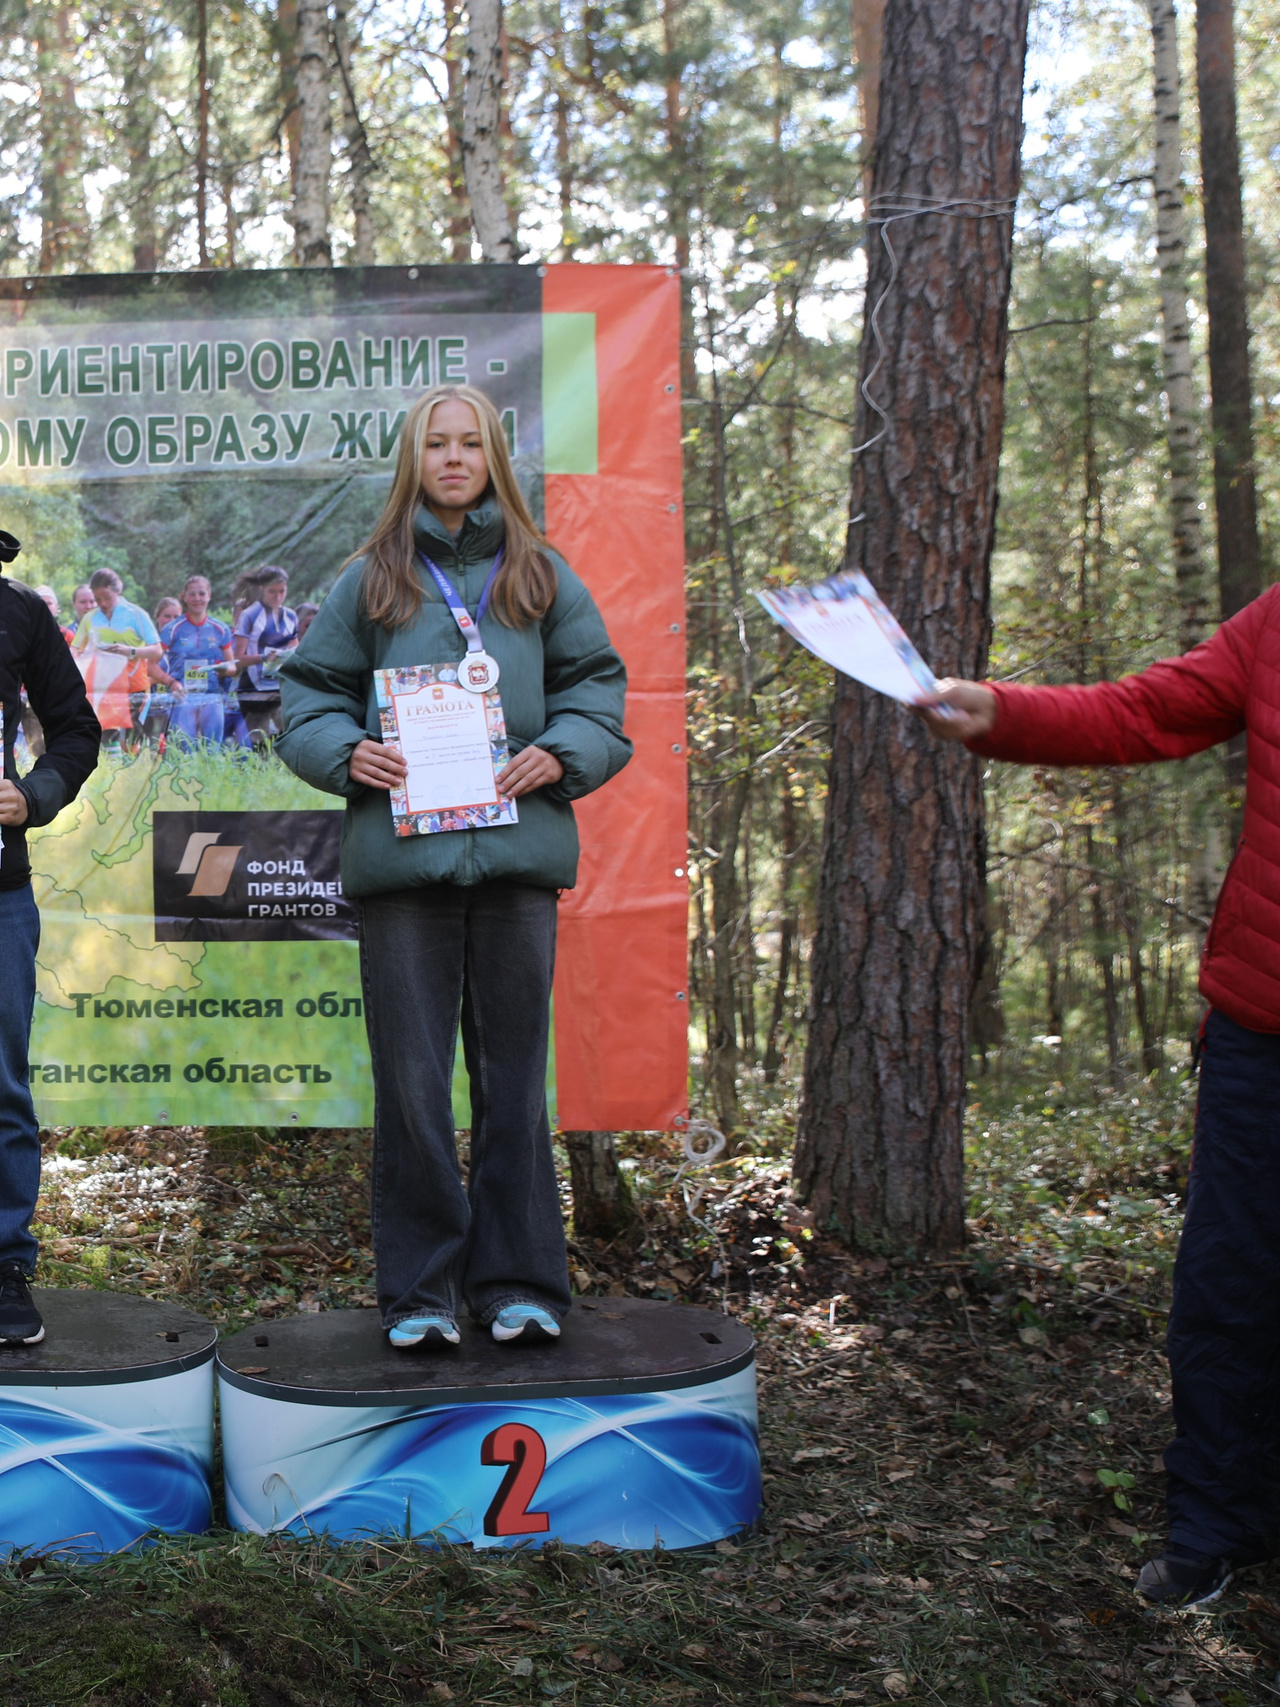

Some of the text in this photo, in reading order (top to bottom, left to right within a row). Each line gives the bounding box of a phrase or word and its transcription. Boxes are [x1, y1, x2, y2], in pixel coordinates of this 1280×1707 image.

[106, 410, 311, 467] ОБРАЗУ
[406, 701, 475, 716] ГРАМОТА
[247, 860, 306, 876] ФОНД
[248, 881, 342, 897] ПРЕЗИДЕ
[248, 903, 337, 917] ГРАНТОВ
[68, 992, 283, 1018] Тюменская
[28, 1057, 332, 1084] ганская область
[480, 1421, 551, 1538] 2
